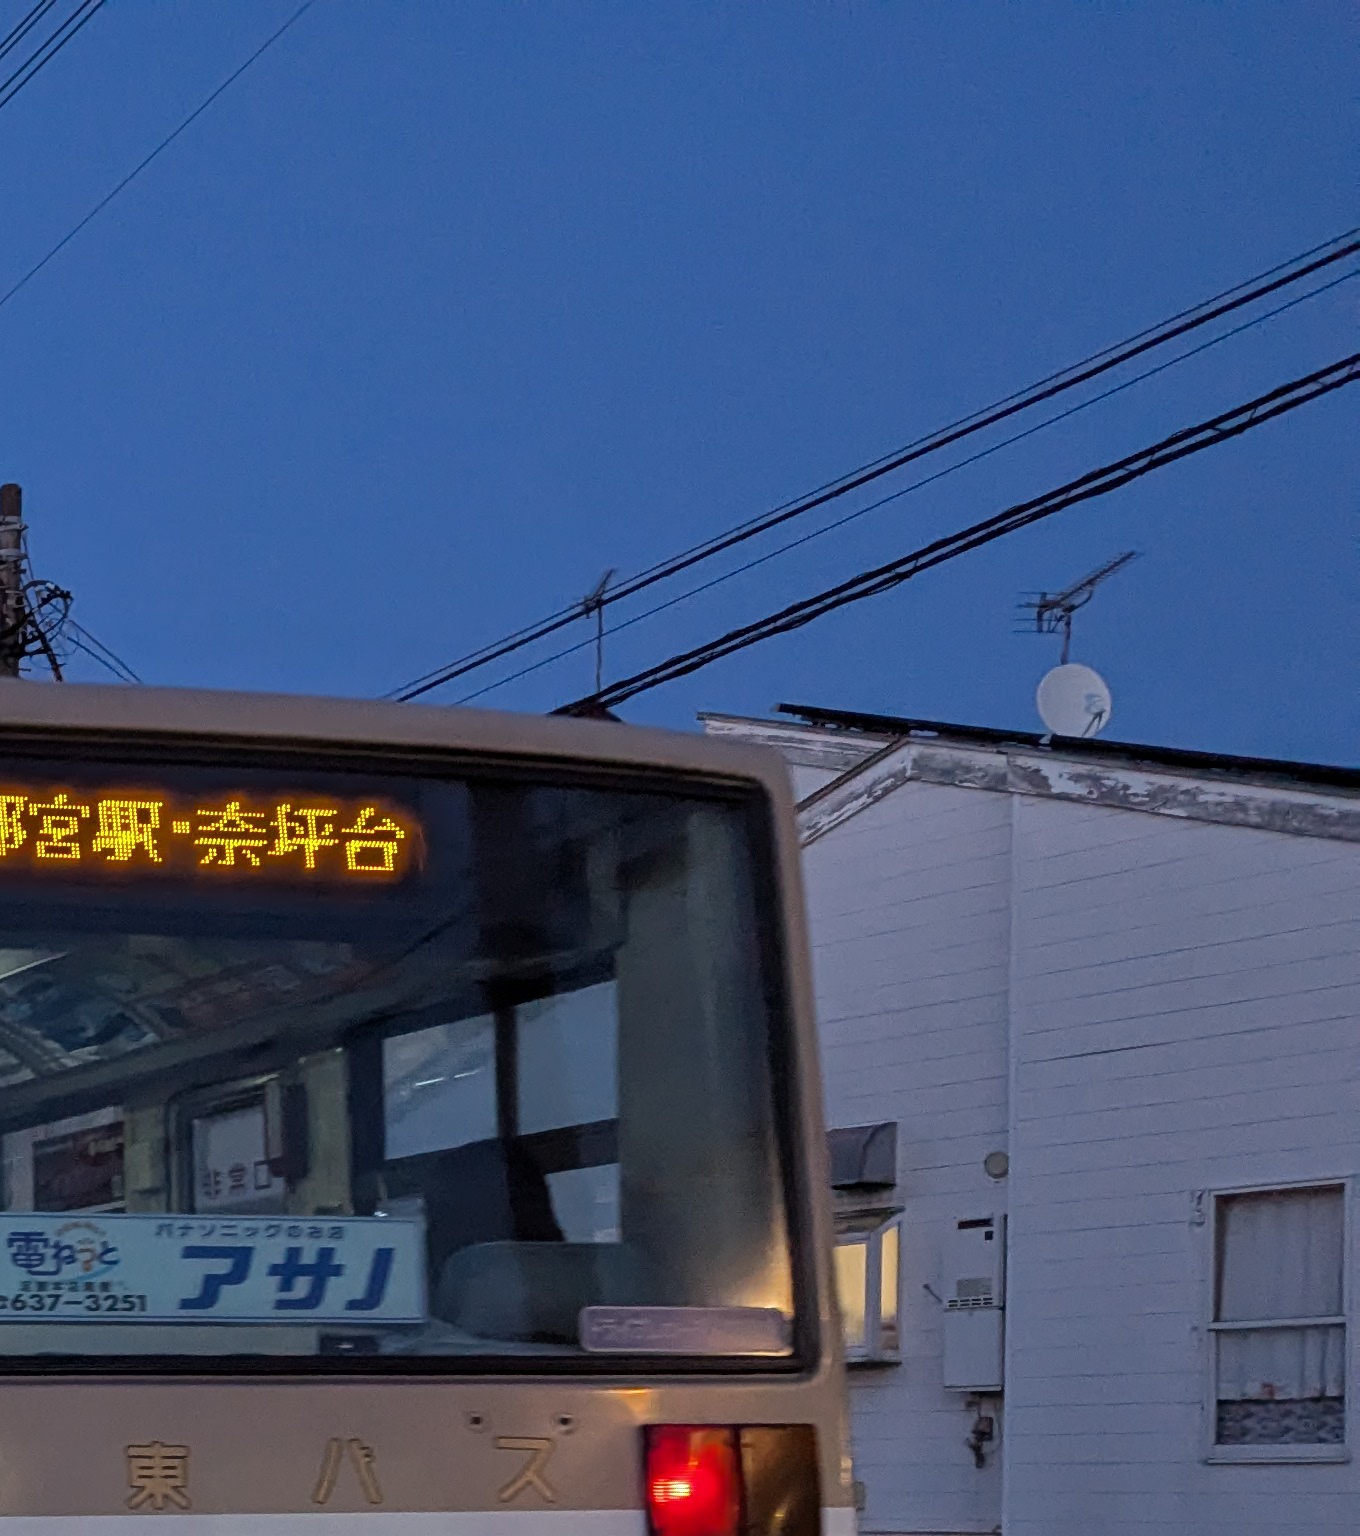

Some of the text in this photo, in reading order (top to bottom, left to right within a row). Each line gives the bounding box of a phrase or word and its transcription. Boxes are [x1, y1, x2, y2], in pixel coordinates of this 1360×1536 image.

[155, 1222, 347, 1241] パナソニックのお店
[177, 1246, 395, 1311] アサノ
